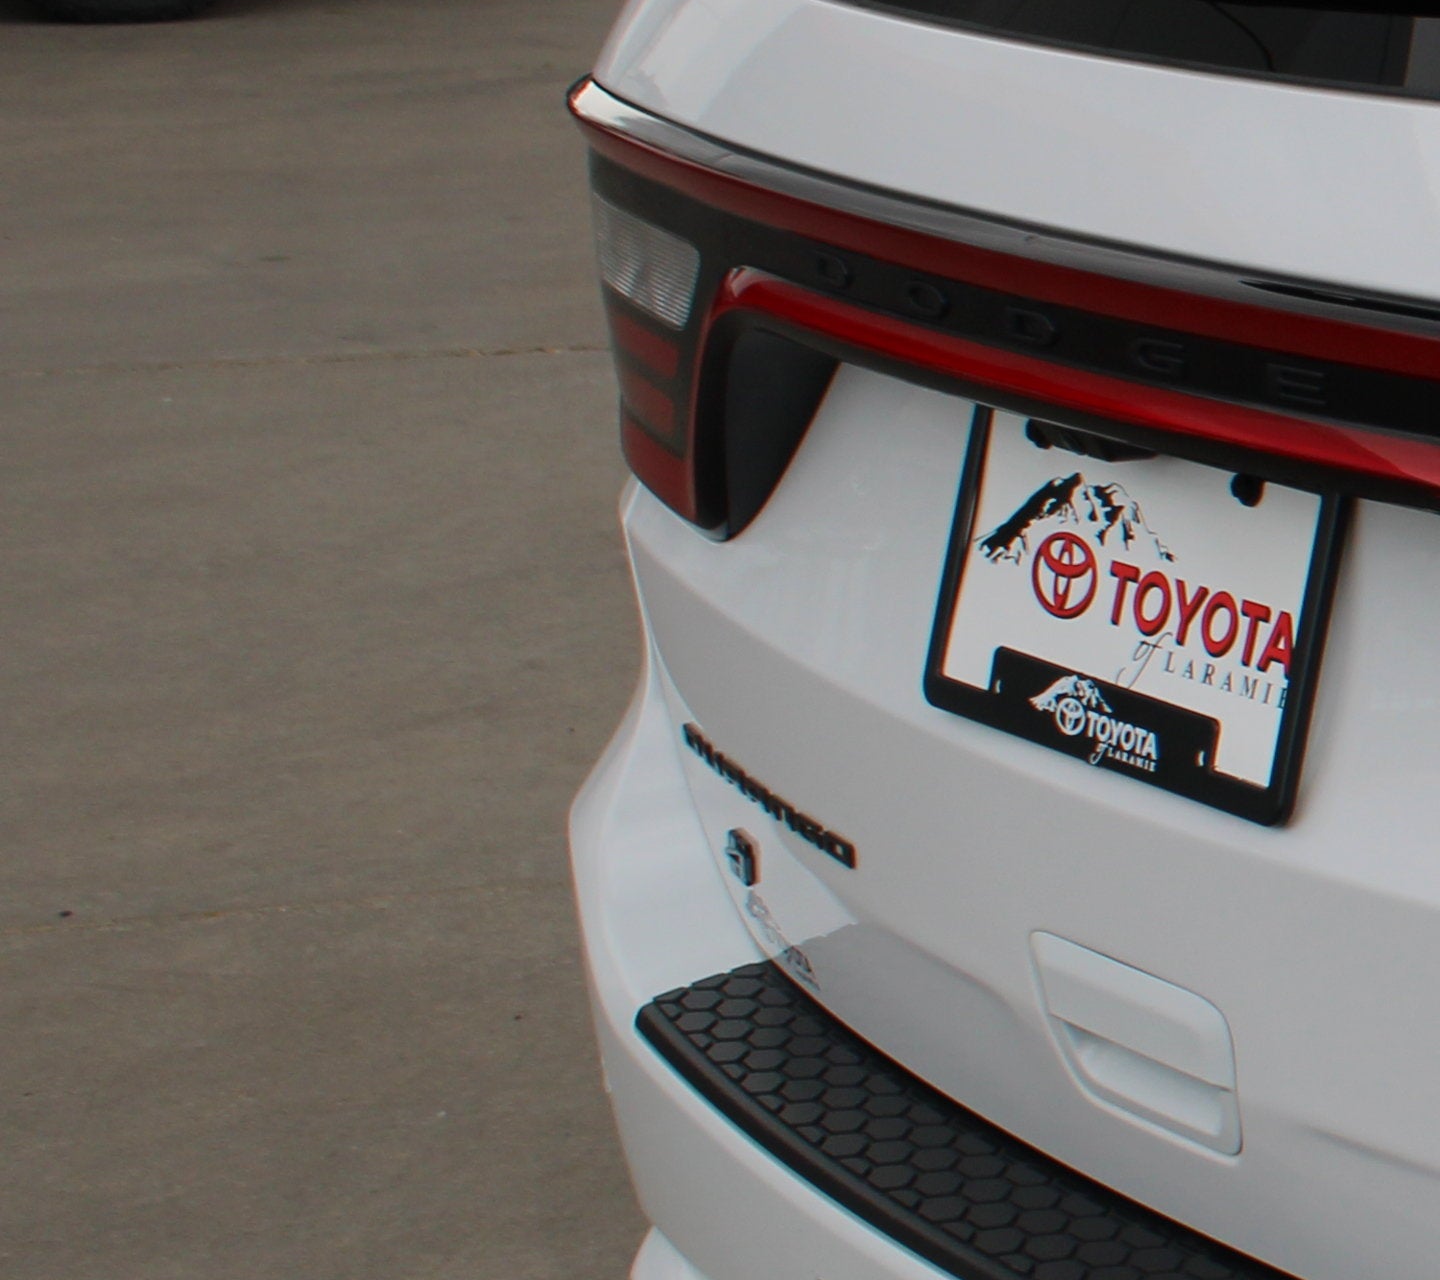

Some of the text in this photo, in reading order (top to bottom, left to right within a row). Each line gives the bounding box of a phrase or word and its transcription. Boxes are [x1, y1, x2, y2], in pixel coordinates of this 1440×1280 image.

[813, 248, 1328, 406] DODGE
[1110, 559, 1296, 680] TOYOTA
[1115, 632, 1173, 690] of
[1086, 711, 1158, 761] TOYOTA
[1107, 746, 1157, 772] LARAMIE
